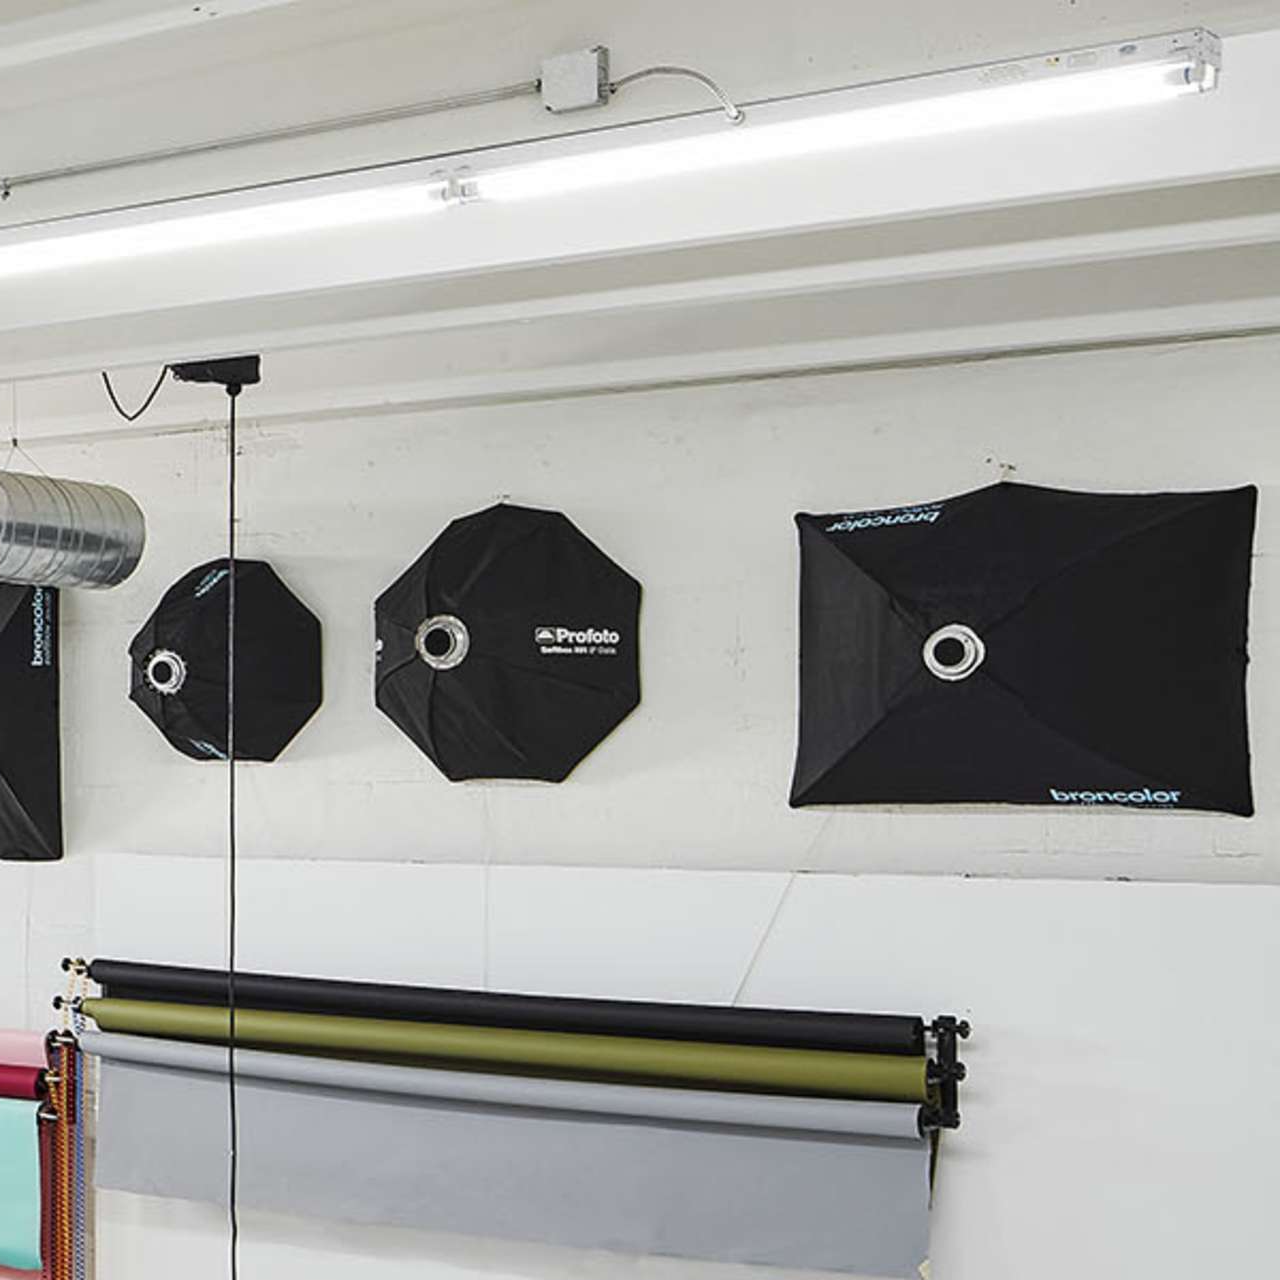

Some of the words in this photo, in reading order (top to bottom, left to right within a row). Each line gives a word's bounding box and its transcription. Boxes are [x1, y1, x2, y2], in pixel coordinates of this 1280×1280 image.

[825, 511, 940, 533] broncolor
[31, 587, 44, 667] broncolor
[556, 627, 621, 644] Profoto
[1048, 787, 1182, 804] broncolor
